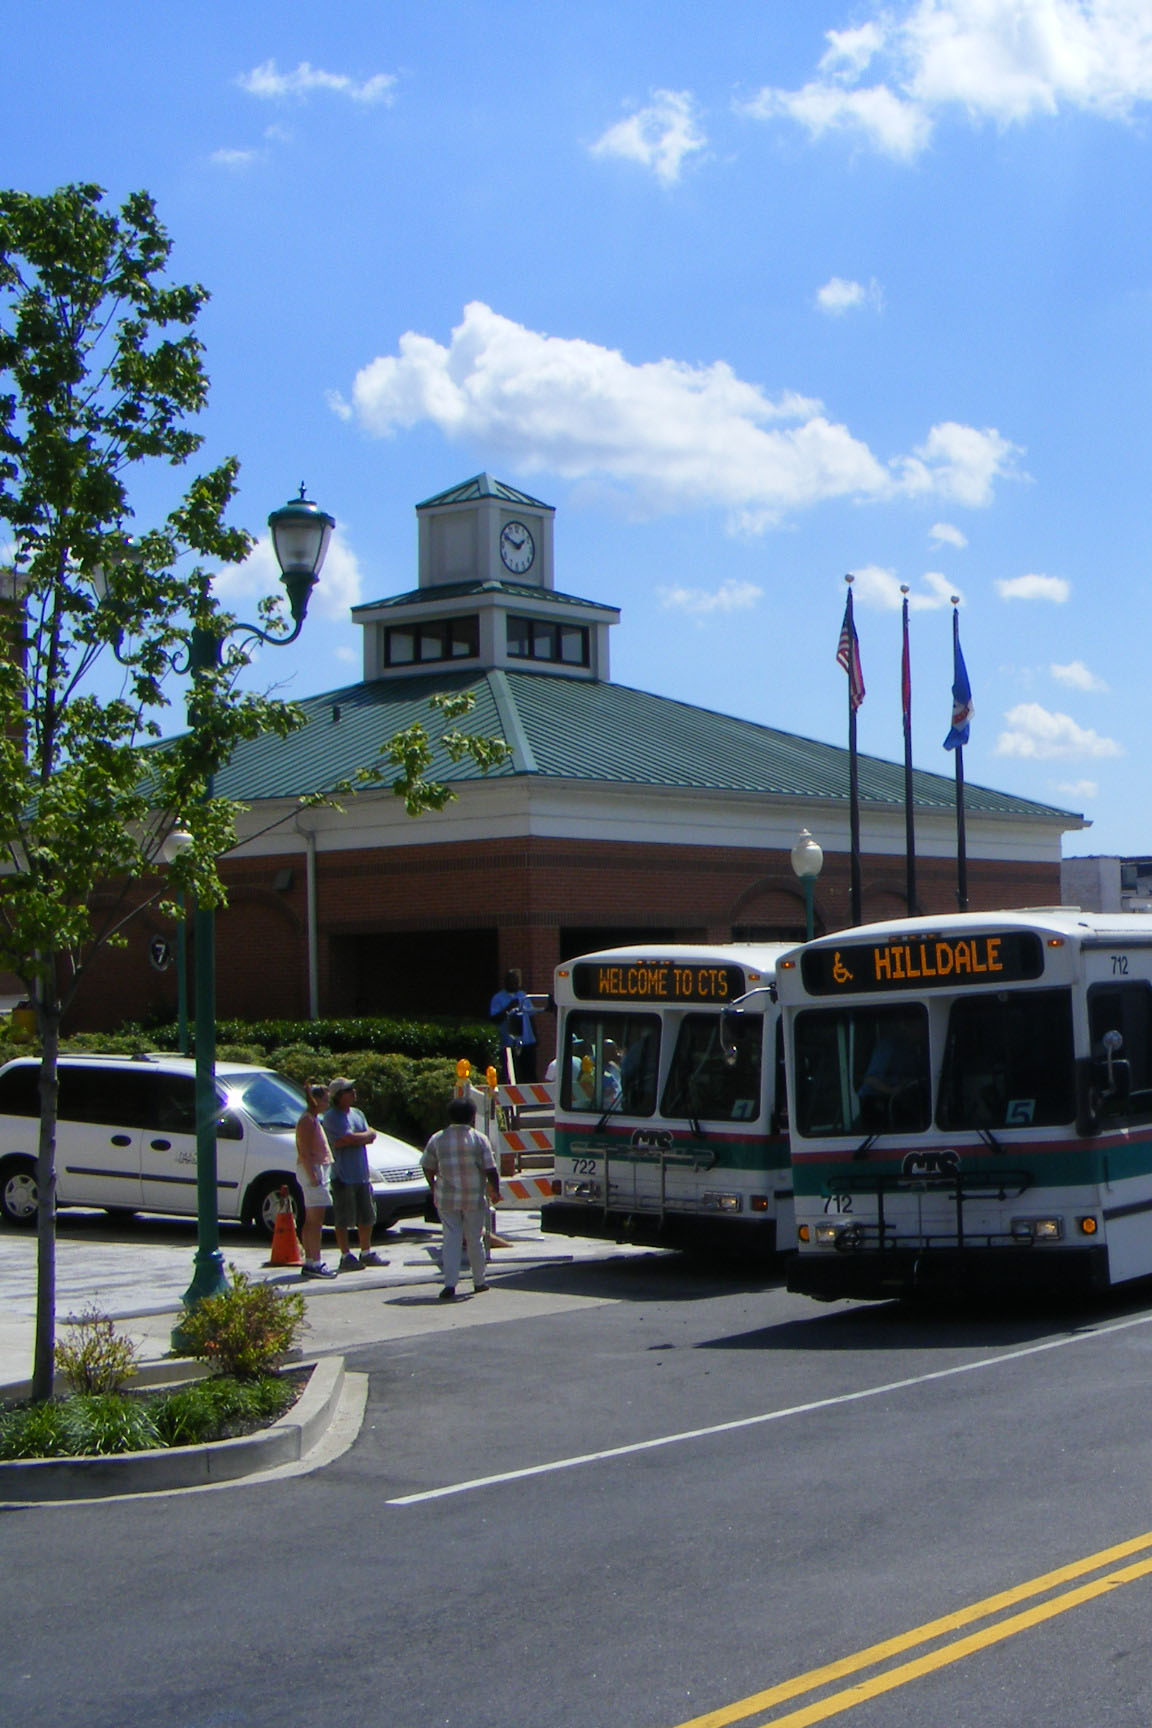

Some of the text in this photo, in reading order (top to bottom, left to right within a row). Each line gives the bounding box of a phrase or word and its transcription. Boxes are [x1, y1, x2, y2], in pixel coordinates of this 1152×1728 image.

[155, 943, 166, 964] 7
[873, 938, 1004, 981] HILLDALE
[1110, 955, 1129, 976] 712
[599, 967, 728, 996] WELCOME TO CTS
[1011, 1101, 1032, 1122] 5
[571, 1158, 597, 1176] 722
[902, 1150, 961, 1180] CTS
[822, 1194, 854, 1214] 712
